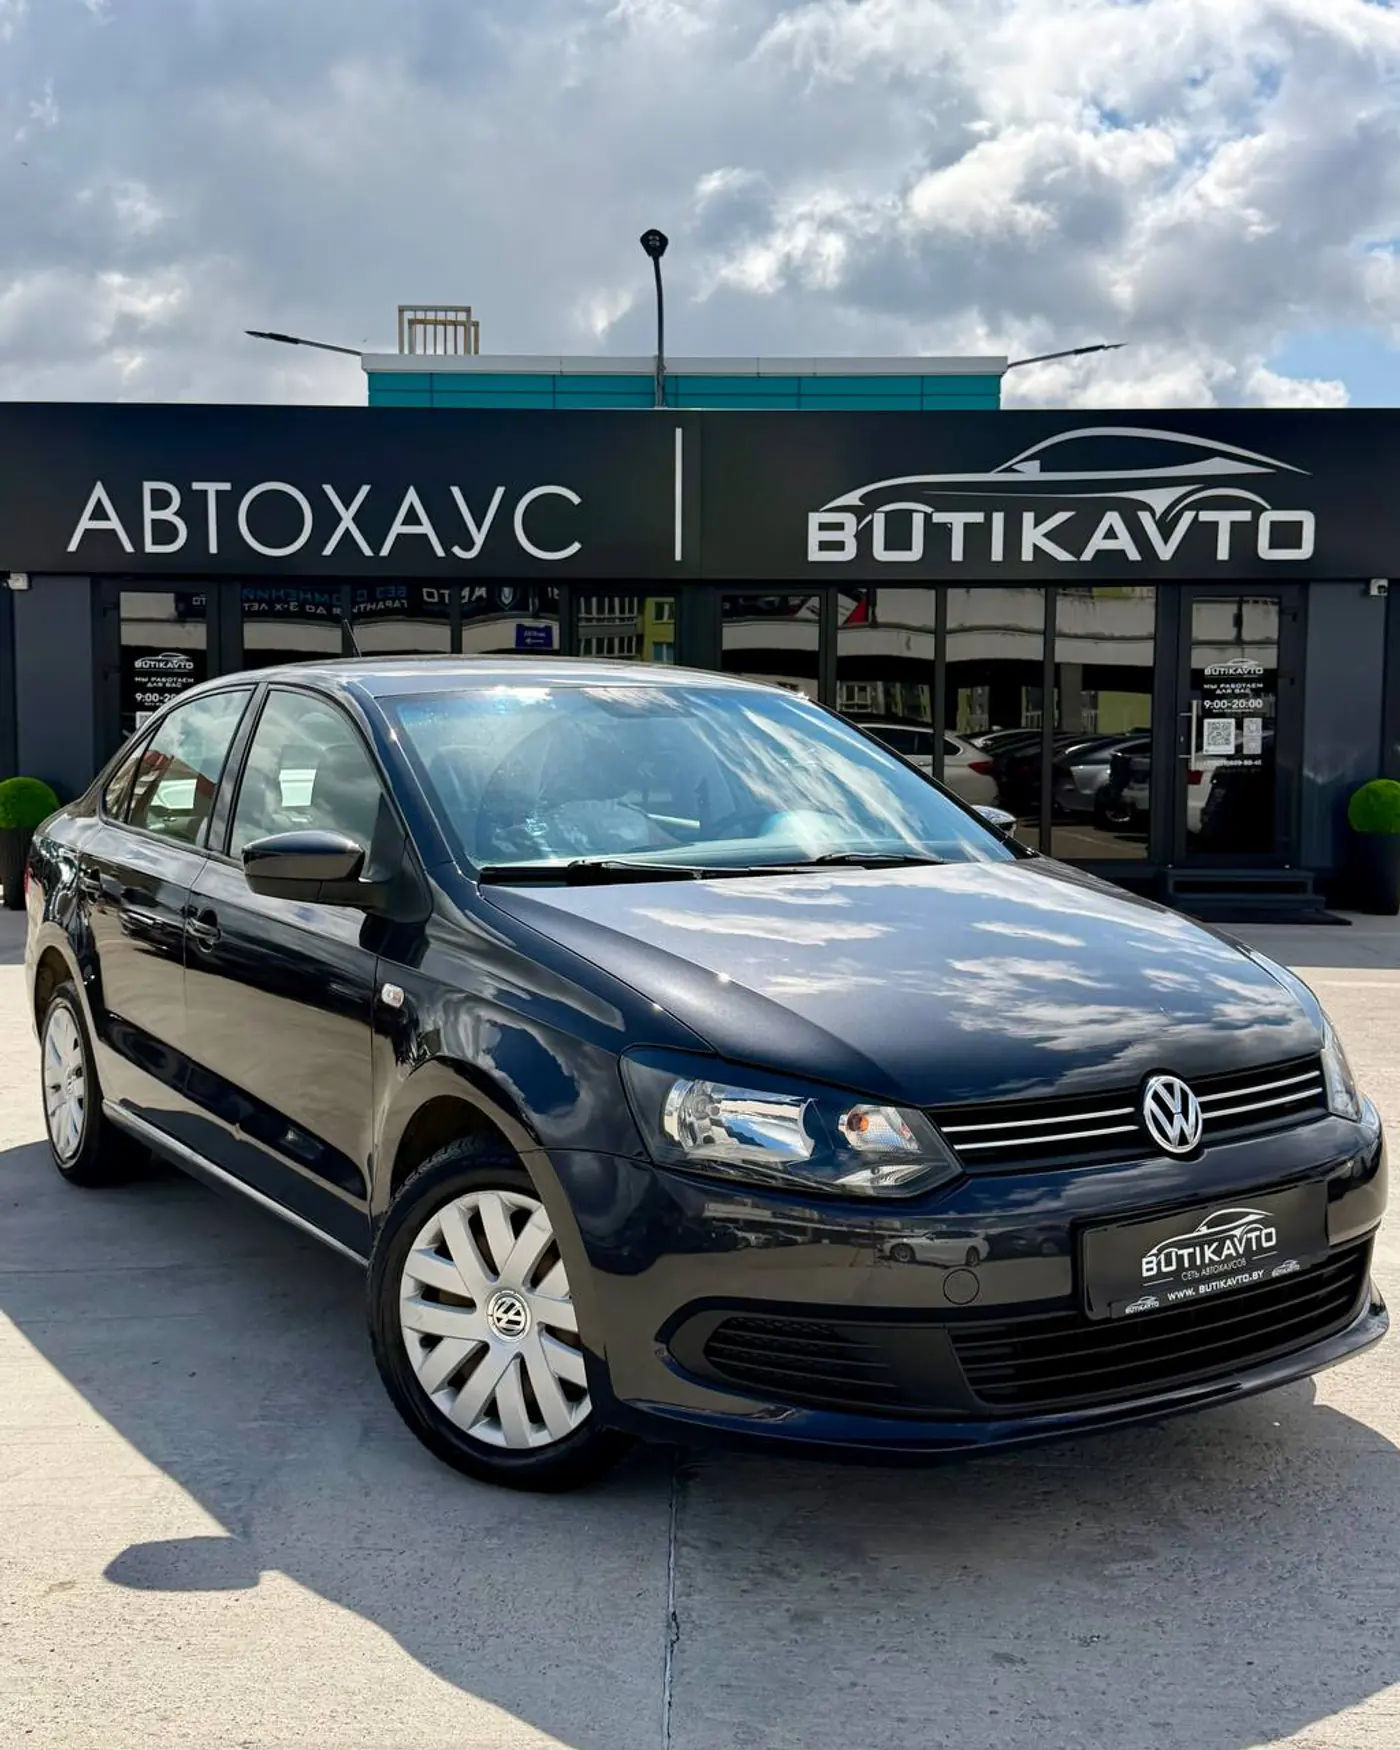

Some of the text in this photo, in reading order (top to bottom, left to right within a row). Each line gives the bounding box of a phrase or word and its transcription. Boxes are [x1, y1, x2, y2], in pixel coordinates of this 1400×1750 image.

[66, 480, 582, 560] АВТОХАУС
[807, 509, 1316, 562] BUTIKAVTO
[1204, 667, 1264, 675] BUTIKAVTO
[1203, 699, 1263, 709] 9:00-20:00
[1141, 1227, 1277, 1277] BUTIKAVTO
[1198, 1269, 1265, 1294] BUTIKAVTO.BY
